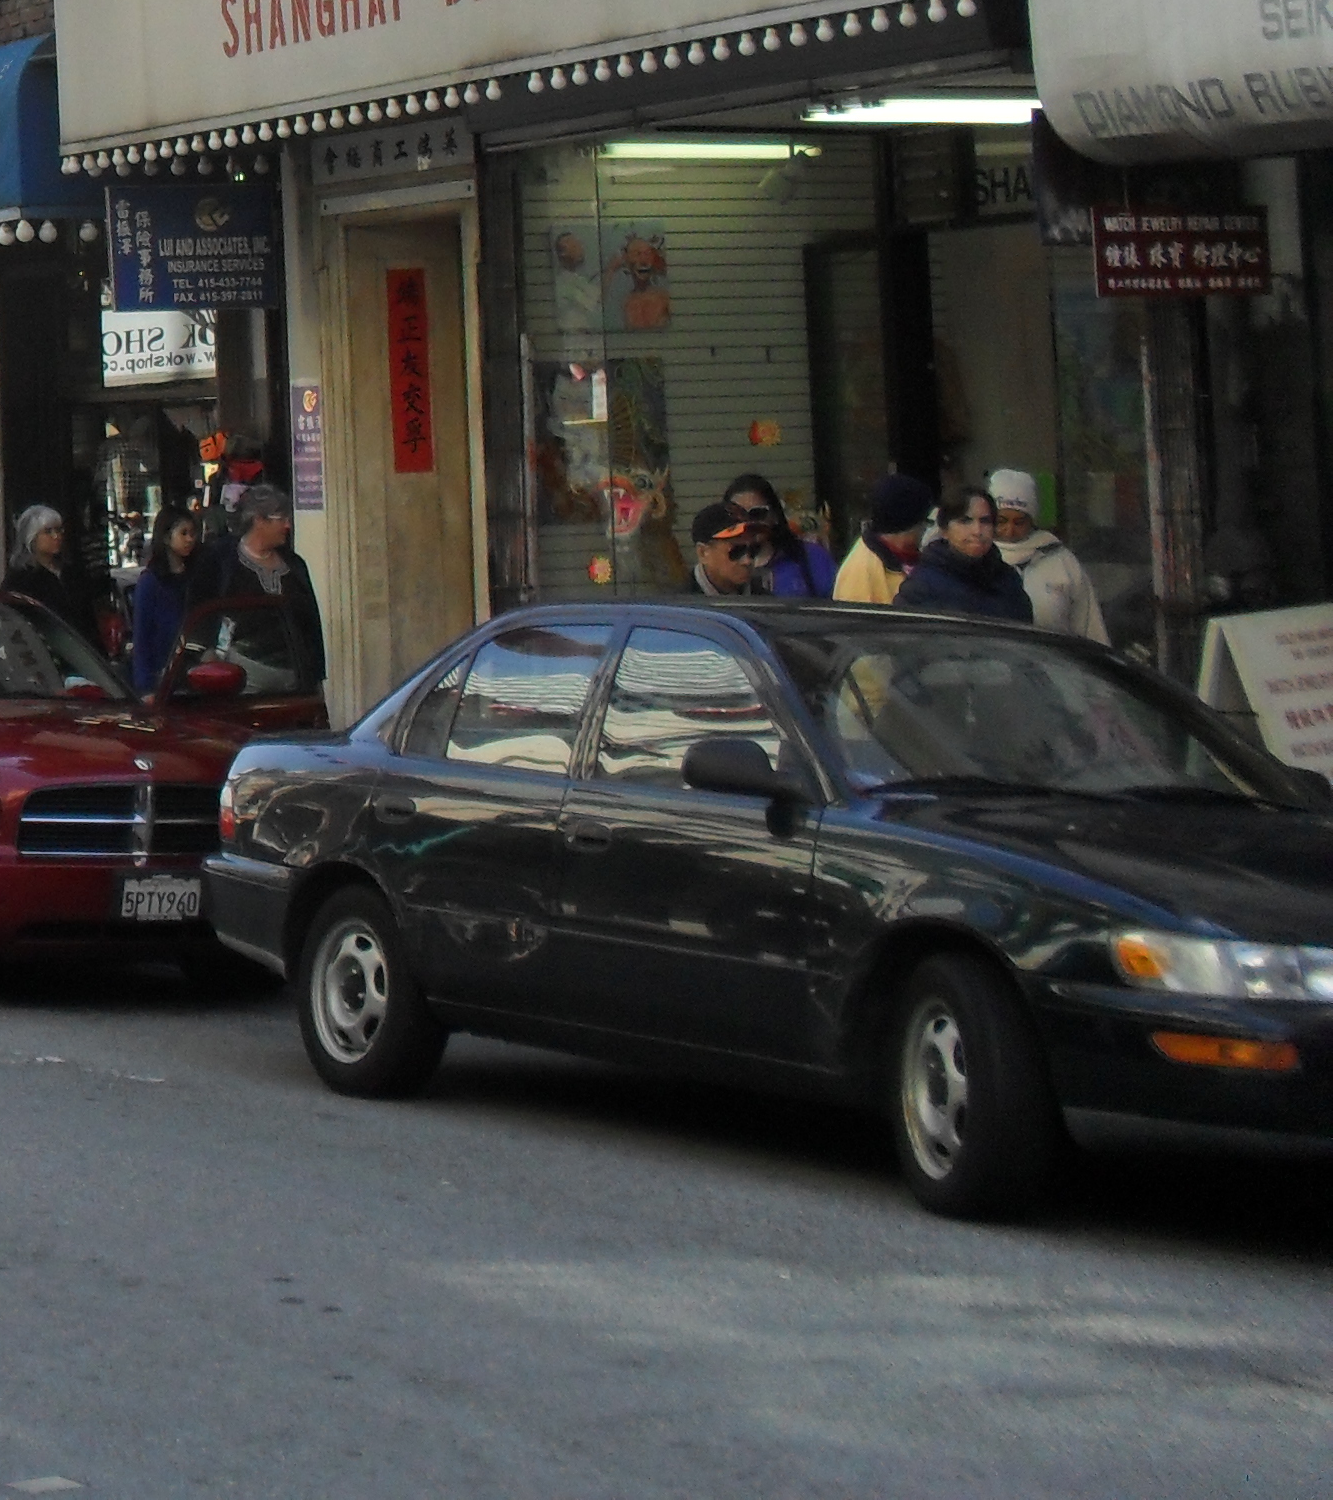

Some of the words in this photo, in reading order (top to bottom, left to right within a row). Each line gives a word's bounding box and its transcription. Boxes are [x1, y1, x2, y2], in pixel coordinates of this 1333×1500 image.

[1073, 77, 1233, 136] DIAMOND
[175, 237, 194, 256] AND
[167, 259, 220, 274] INSURANCE
[221, 258, 265, 273] SERVICES
[124, 890, 198, 918] 5PTY960
